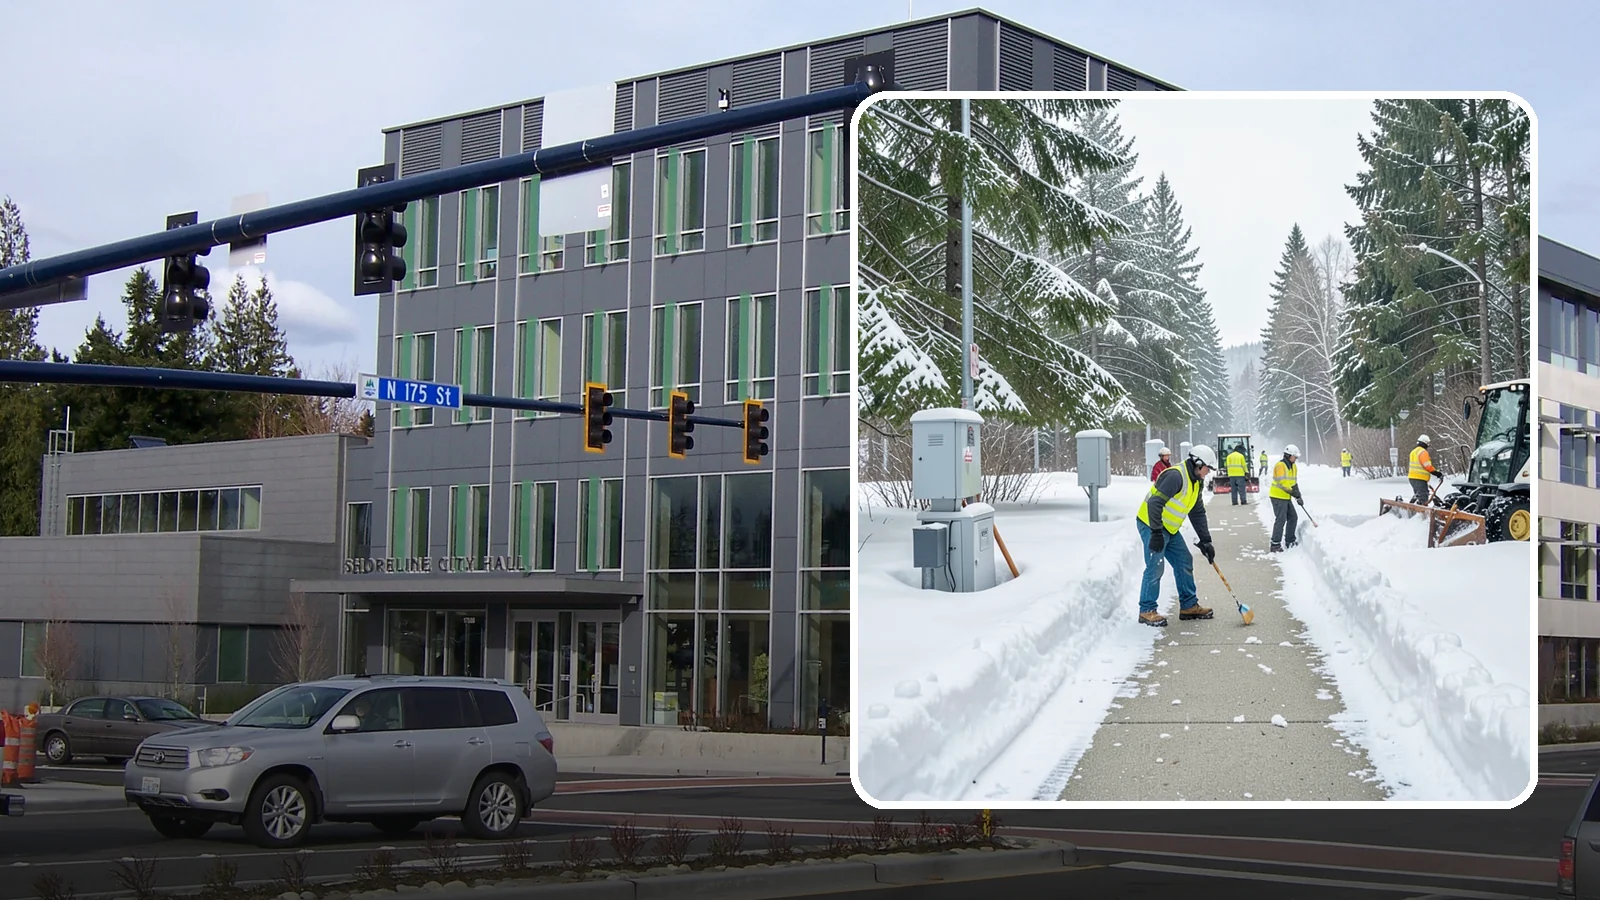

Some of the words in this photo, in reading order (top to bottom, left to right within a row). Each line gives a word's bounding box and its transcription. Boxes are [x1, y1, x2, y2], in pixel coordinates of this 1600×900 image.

[387, 380, 396, 400] N
[405, 382, 428, 403] 175
[436, 386, 451, 406] St
[344, 556, 432, 574] SHORELINE
[438, 556, 475, 573] CITY
[483, 555, 526, 572] HALL
